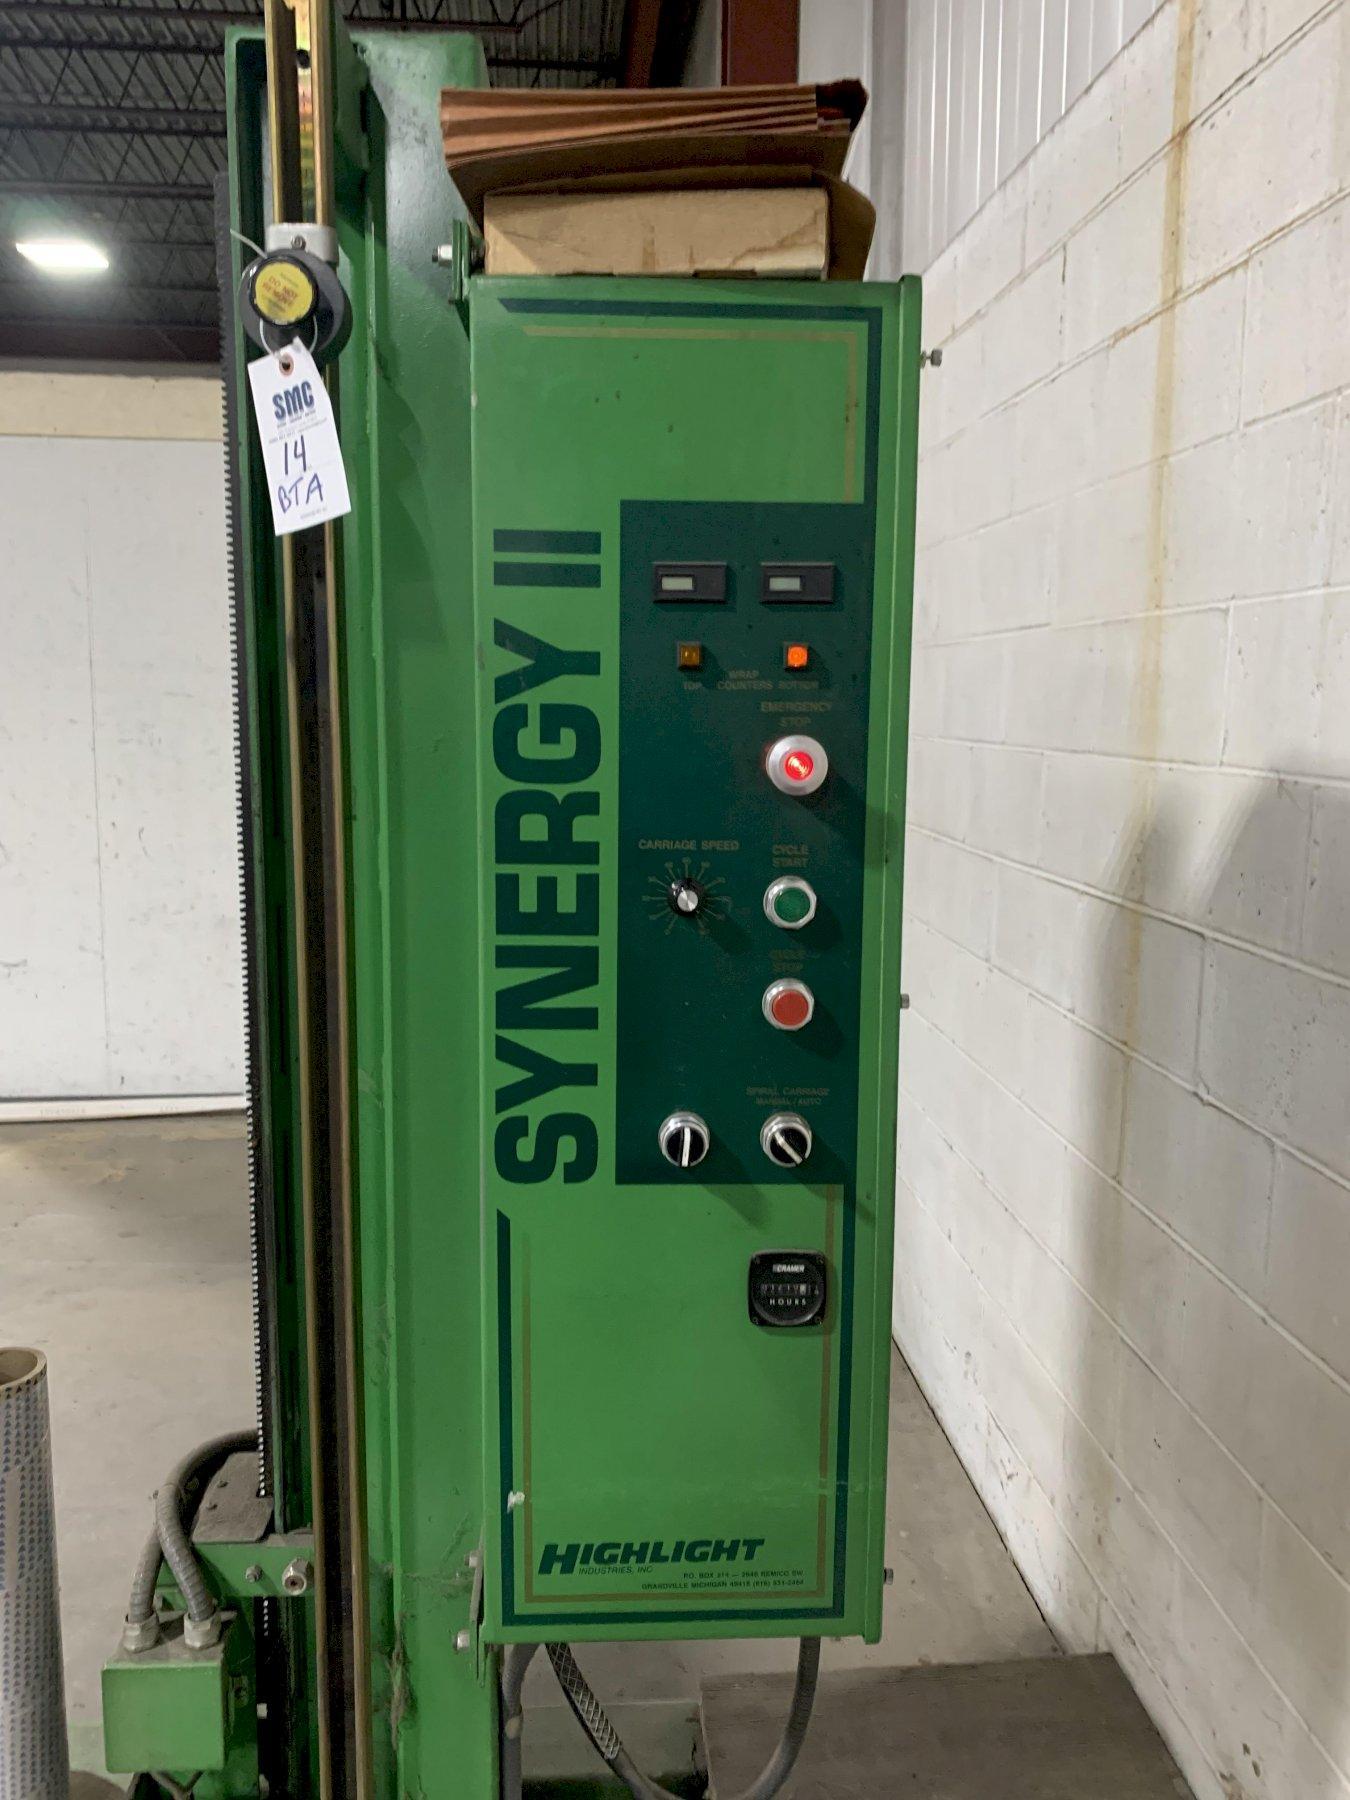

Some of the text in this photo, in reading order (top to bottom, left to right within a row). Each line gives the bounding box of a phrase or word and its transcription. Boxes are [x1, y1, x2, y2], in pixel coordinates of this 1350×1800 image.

[272, 380, 315, 421] SMC
[284, 434, 307, 475] 14
[277, 473, 324, 514] BTA
[716, 680, 774, 690] COUNTERS
[760, 701, 833, 712] EMERGENCY
[778, 716, 812, 728] STOP
[638, 839, 740, 850] CARRIAGE SPEED
[772, 844, 810, 855] CYCLE
[772, 858, 809, 868] START
[493, 617, 602, 1184] SYNERGY
[769, 1298, 807, 1306] HOURS
[538, 1538, 765, 1575] HIGHLIGHT
[641, 1582, 689, 1590] GRANDVILLE
[691, 1581, 728, 1589] MICHIGAN
